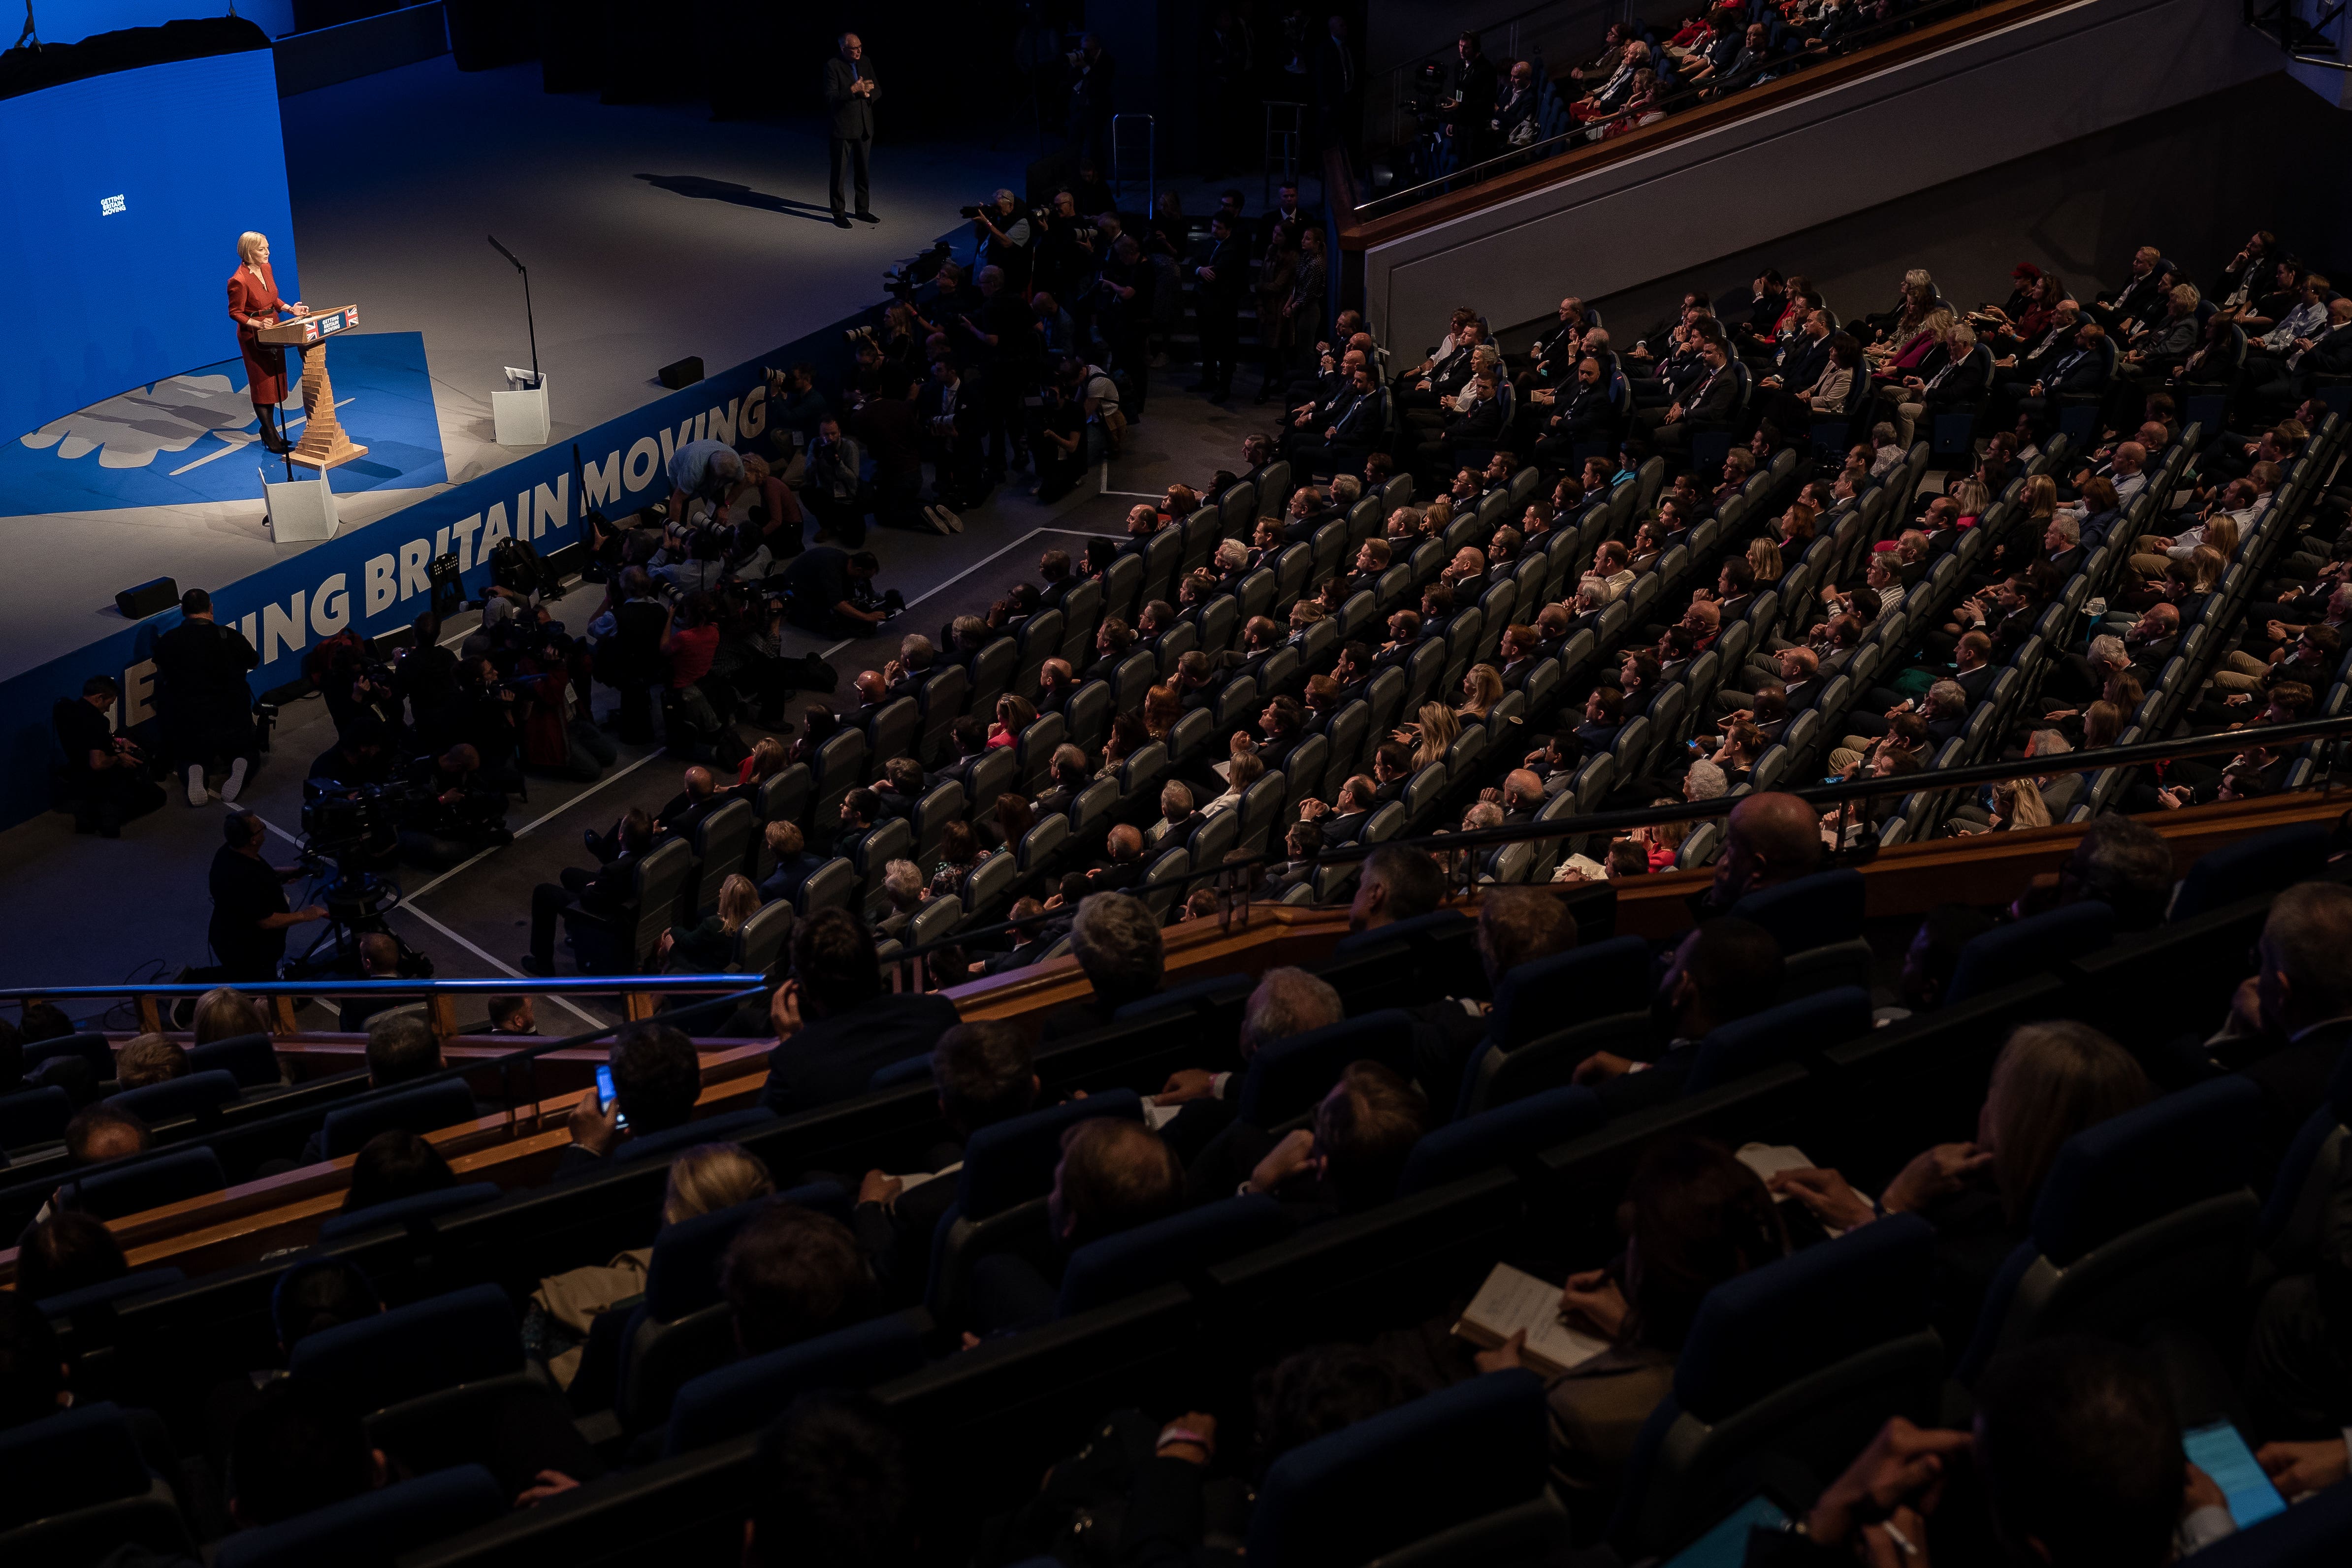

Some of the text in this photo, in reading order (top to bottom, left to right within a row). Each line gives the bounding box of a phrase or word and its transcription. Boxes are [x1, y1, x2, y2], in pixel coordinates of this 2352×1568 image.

[100, 194, 125, 205] GETTING
[102, 200, 124, 211] BRITAIN
[102, 204, 127, 216] MOVING
[322, 315, 339, 325] GETTING
[323, 320, 339, 329] BRITAIN
[323, 323, 340, 334] MOVING
[103, 574, 350, 734] EING
